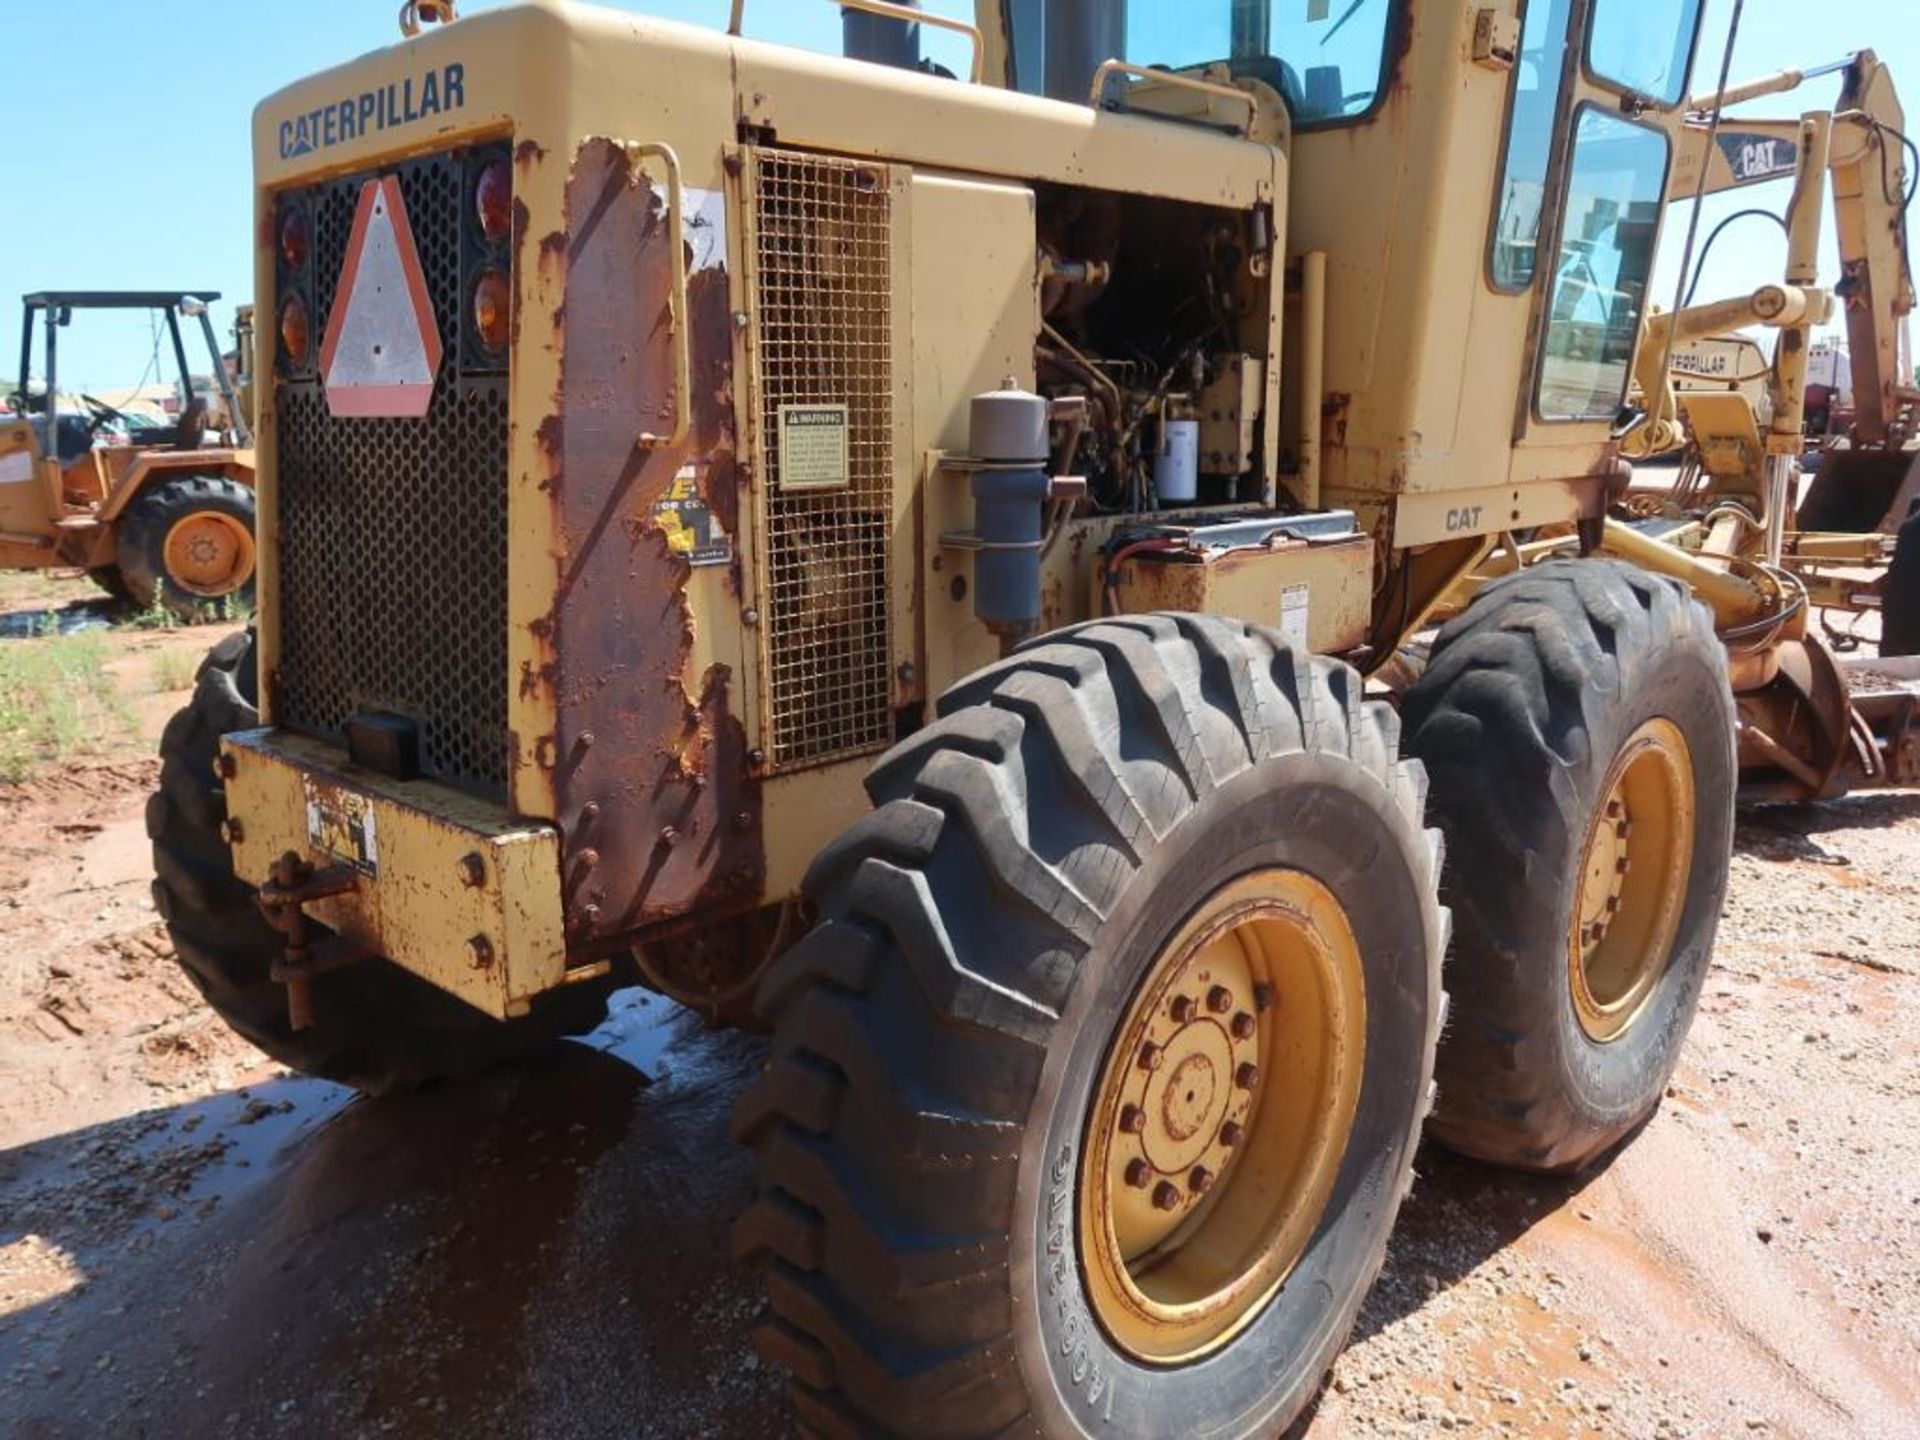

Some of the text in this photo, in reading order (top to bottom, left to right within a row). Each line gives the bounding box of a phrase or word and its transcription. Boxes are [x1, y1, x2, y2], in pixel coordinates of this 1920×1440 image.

[279, 63, 464, 159] CATERPILLAR
[1741, 140, 1777, 176] CAT
[1670, 354, 1726, 374] TERPILLAR
[799, 413, 842, 424] WARNING
[1446, 505, 1483, 531] CAT
